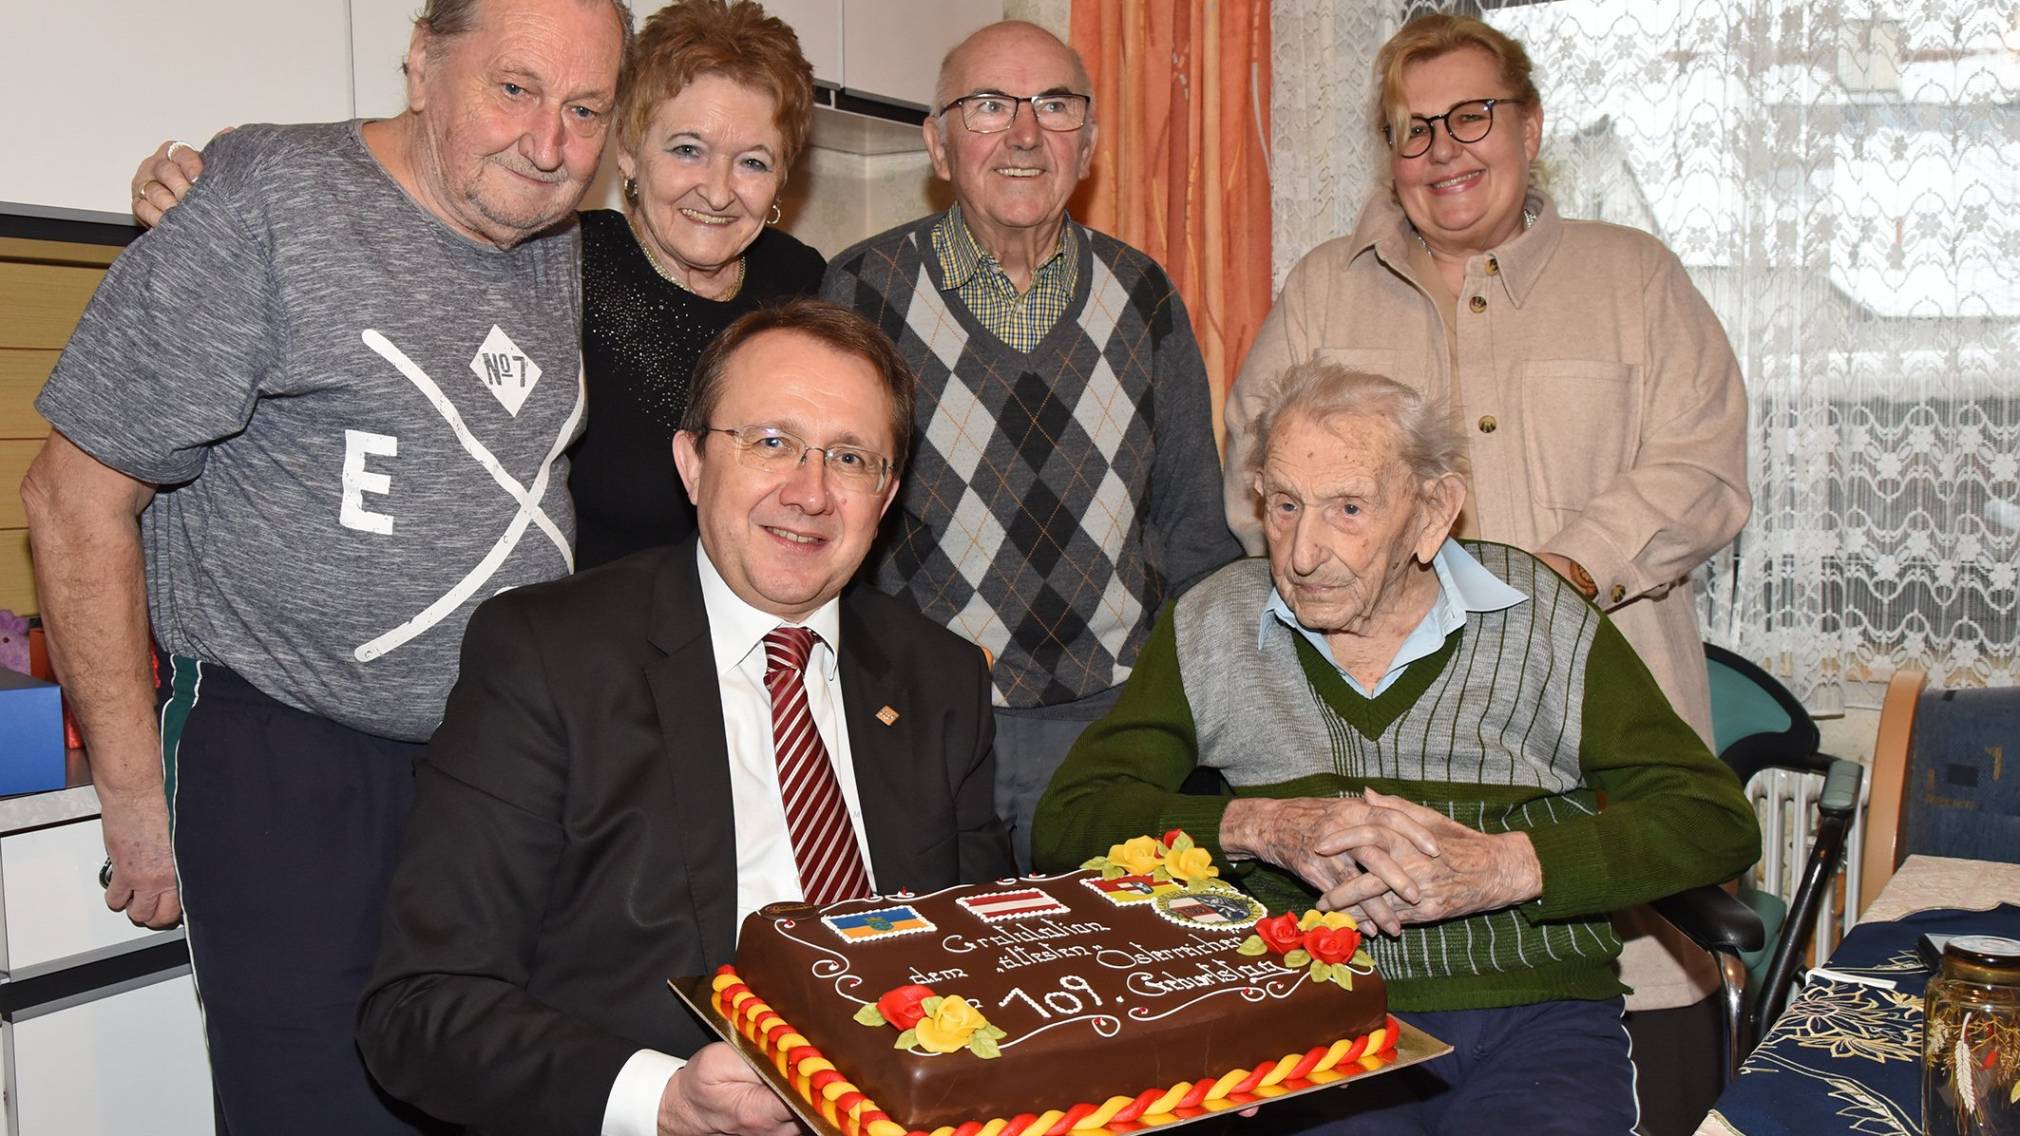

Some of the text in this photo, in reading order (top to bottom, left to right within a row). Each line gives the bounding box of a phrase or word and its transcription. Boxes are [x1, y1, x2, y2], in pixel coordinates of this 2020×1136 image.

[339, 429, 398, 536] E
[942, 918, 1112, 953] Gratulation
[908, 966, 969, 985] dem
[1126, 958, 1300, 996] Geburtstag
